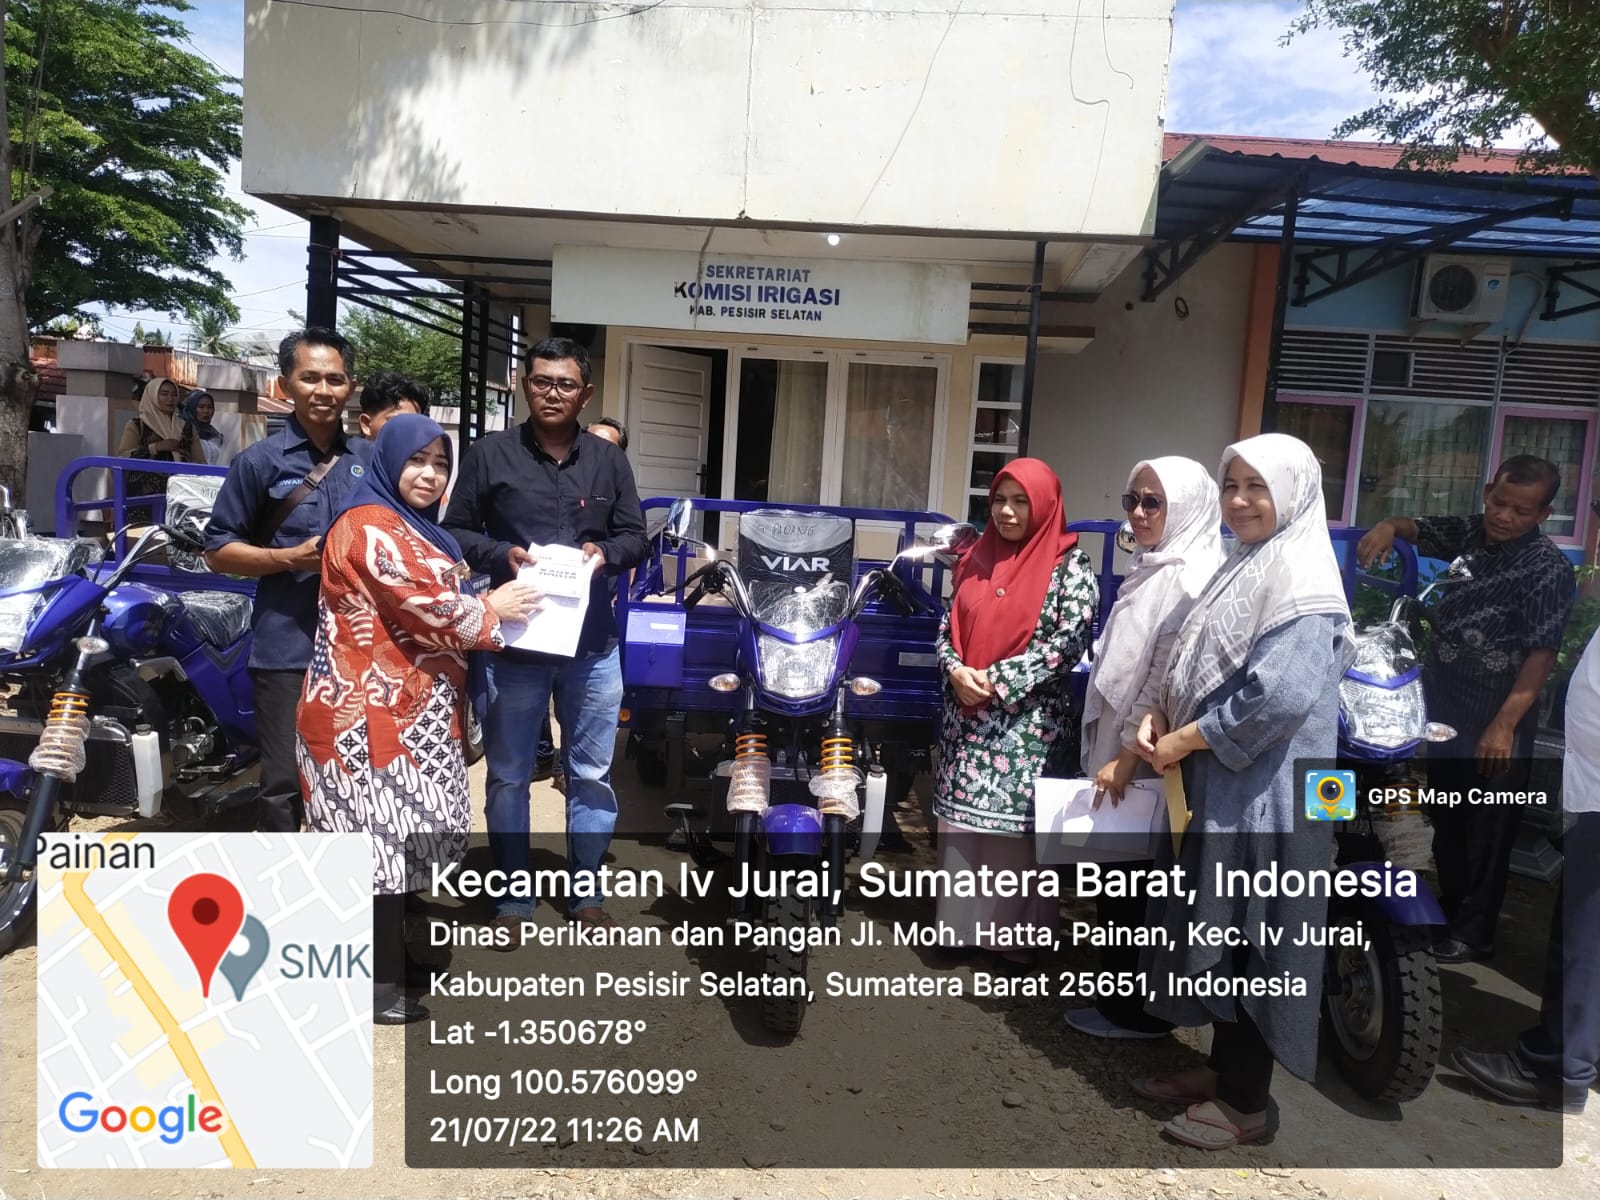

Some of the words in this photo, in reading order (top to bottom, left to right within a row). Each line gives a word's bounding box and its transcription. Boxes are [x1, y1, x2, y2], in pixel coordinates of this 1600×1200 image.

[706, 264, 811, 283] SEKRETARIAT
[674, 281, 752, 302] KOMISI
[757, 285, 840, 306] IRIGASI
[720, 306, 766, 319] PESISIR
[770, 308, 822, 322] SELATAN
[760, 555, 831, 572] VIAR
